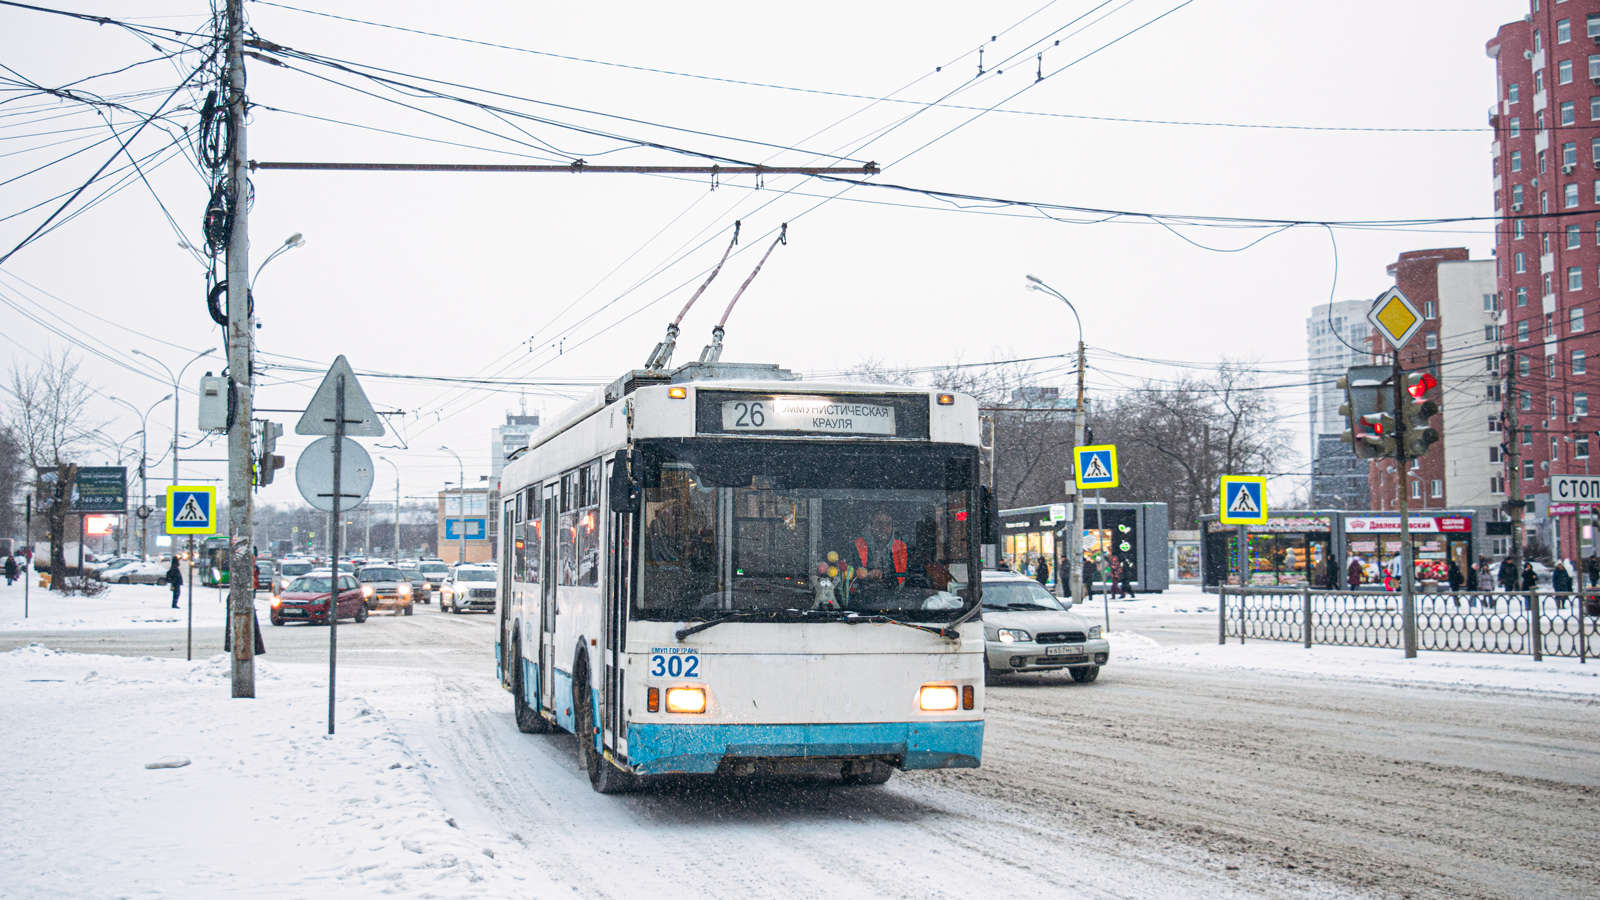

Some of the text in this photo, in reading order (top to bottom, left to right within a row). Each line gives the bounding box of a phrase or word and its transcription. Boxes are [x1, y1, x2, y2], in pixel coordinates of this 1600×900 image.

[734, 402, 765, 427] 26
[812, 417, 853, 429] КРАУЛЯ
[1369, 520, 1431, 531] Давлекавский
[651, 654, 699, 678] 302
